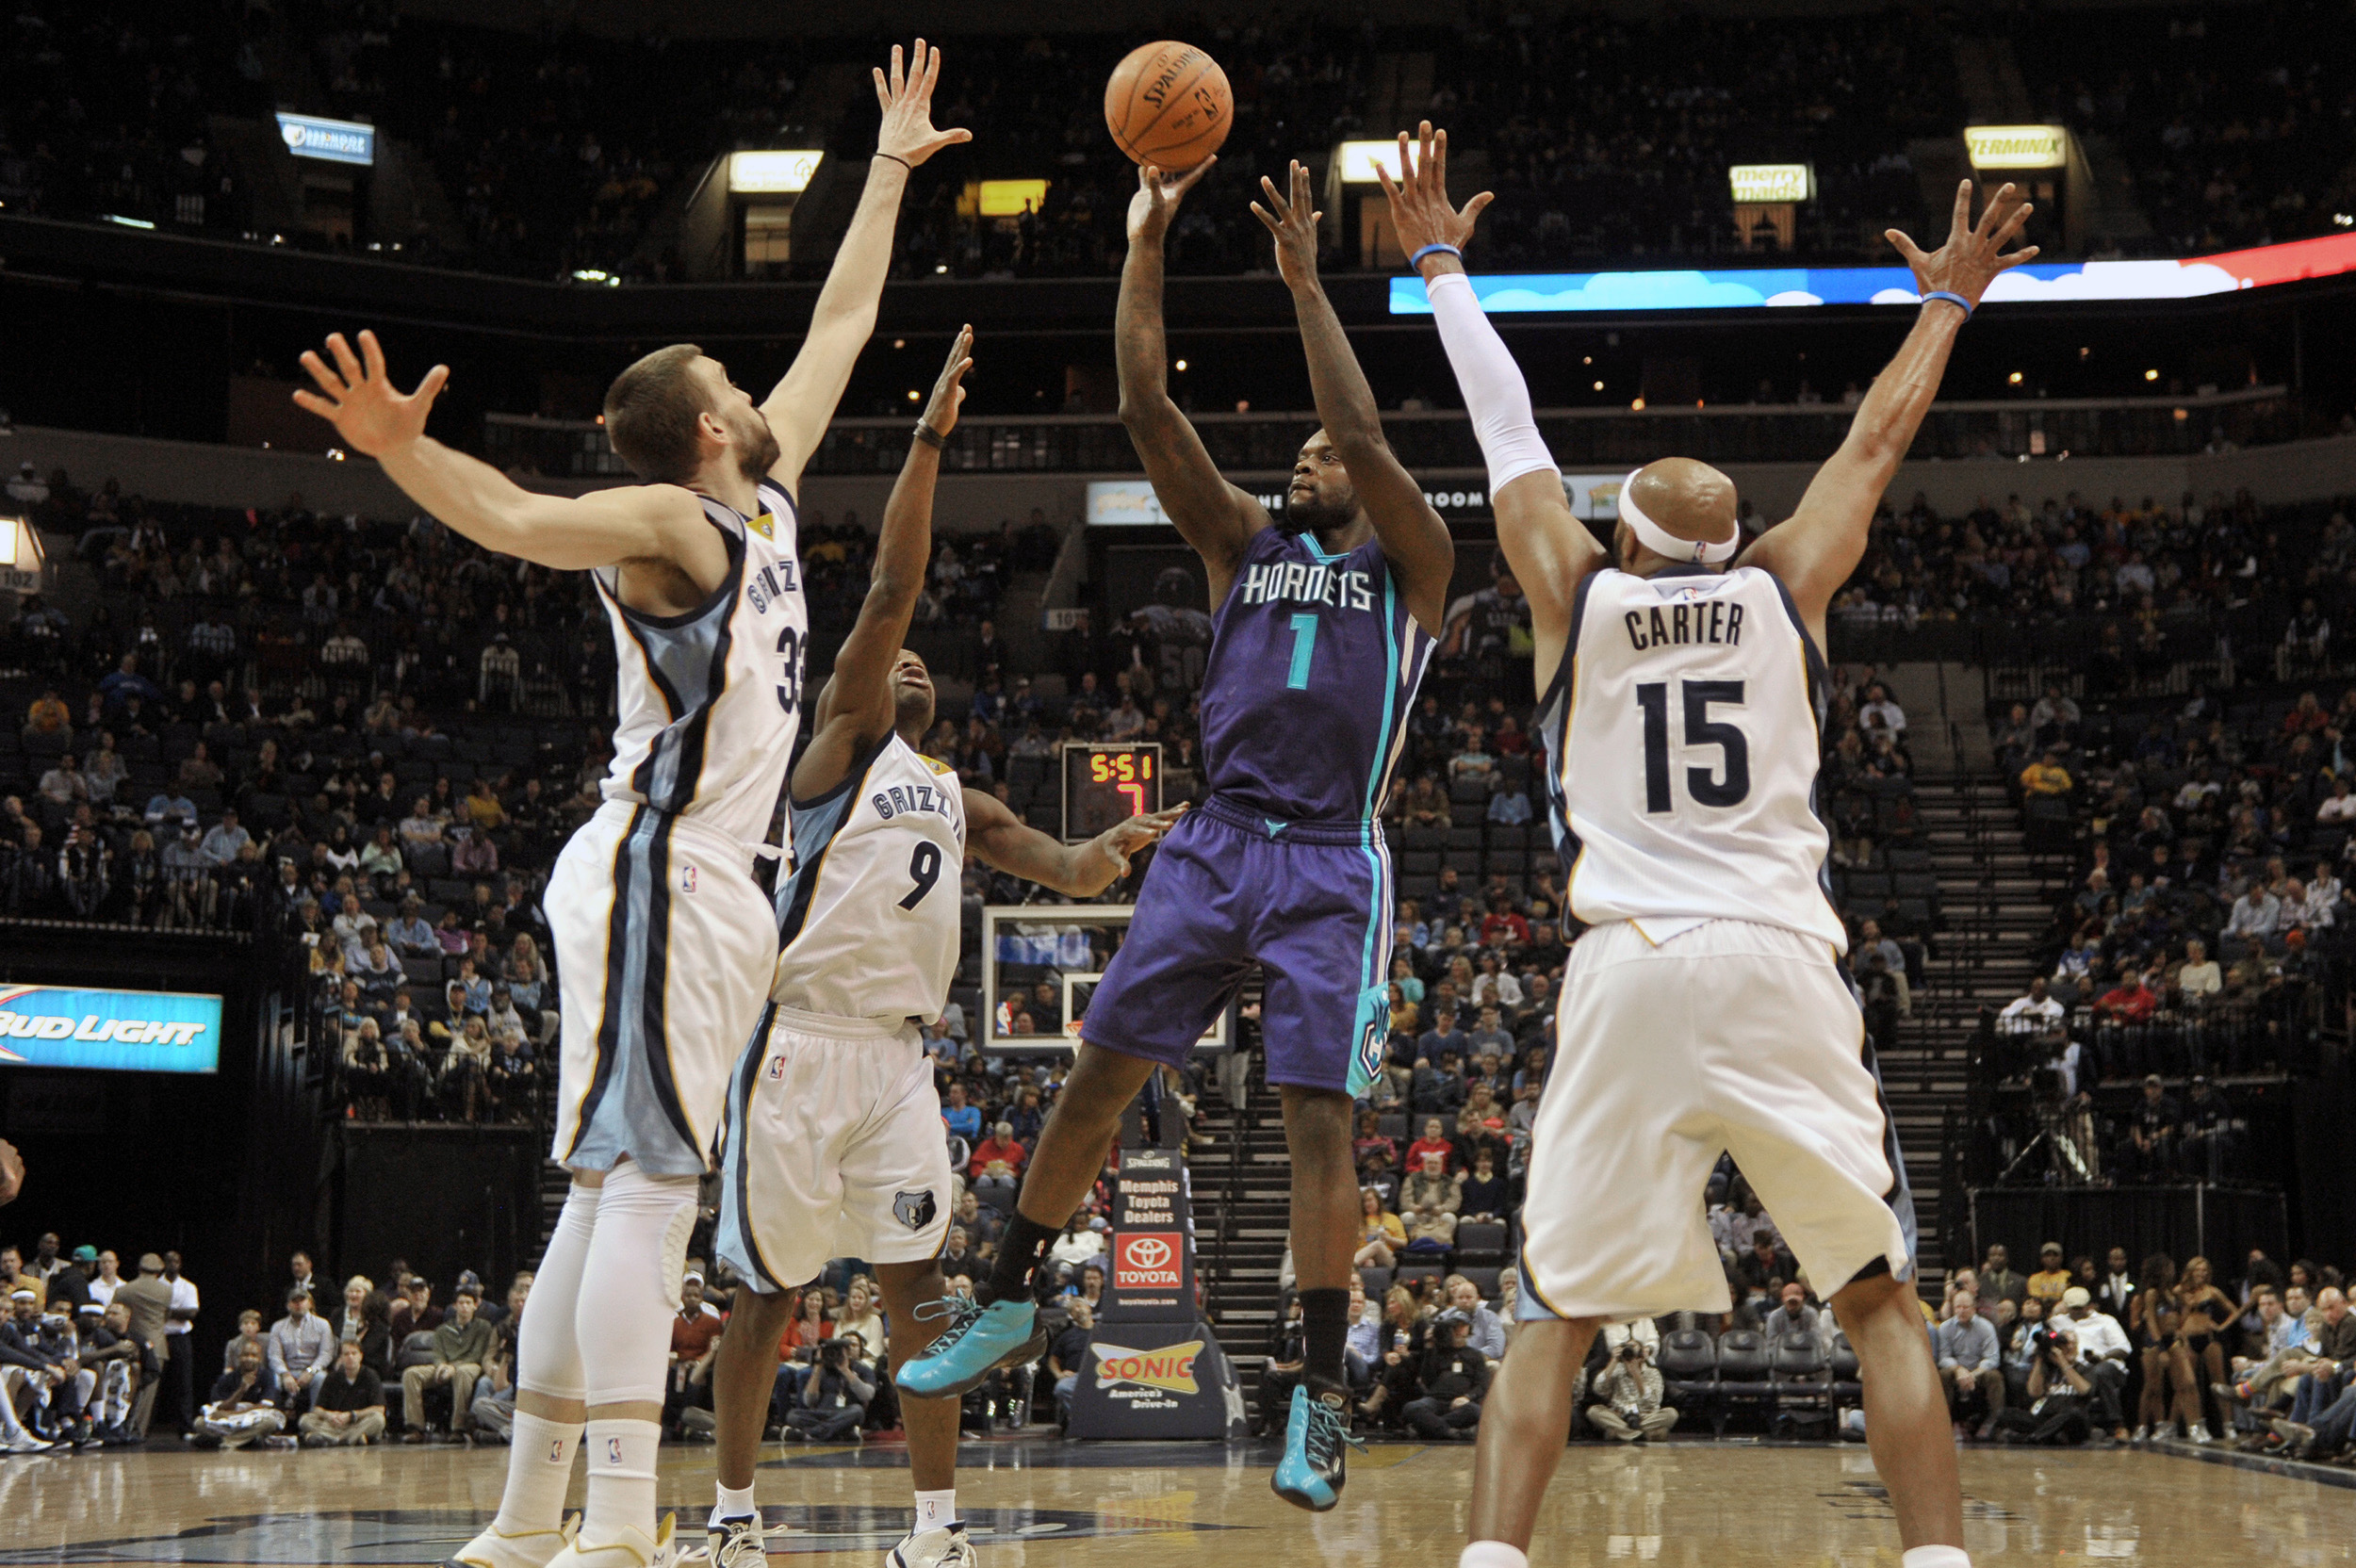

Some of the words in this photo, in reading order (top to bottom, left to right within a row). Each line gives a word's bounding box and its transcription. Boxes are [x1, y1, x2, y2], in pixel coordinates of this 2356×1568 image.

[1737, 169, 1802, 183] merry
[1258, 494, 1283, 510] HE
[1241, 561, 1377, 612] HORNETS
[1625, 600, 1744, 651] CARTER
[1286, 612, 1319, 691] 1
[1635, 678, 1750, 813] 15
[1090, 753, 1152, 783] 5:51
[1116, 783, 1144, 818] 7
[896, 840, 942, 912] 9
[74, 1015, 206, 1046] LIGHT
[1126, 1156, 1170, 1168] SPALDING
[1119, 1180, 1179, 1194] Memphis
[1127, 1195, 1170, 1209] Toyota
[1124, 1210, 1174, 1224] Dealers
[1118, 1270, 1179, 1283] TOYOTA
[1102, 1357, 1194, 1380] SONIC
[1108, 1387, 1163, 1398] America's
